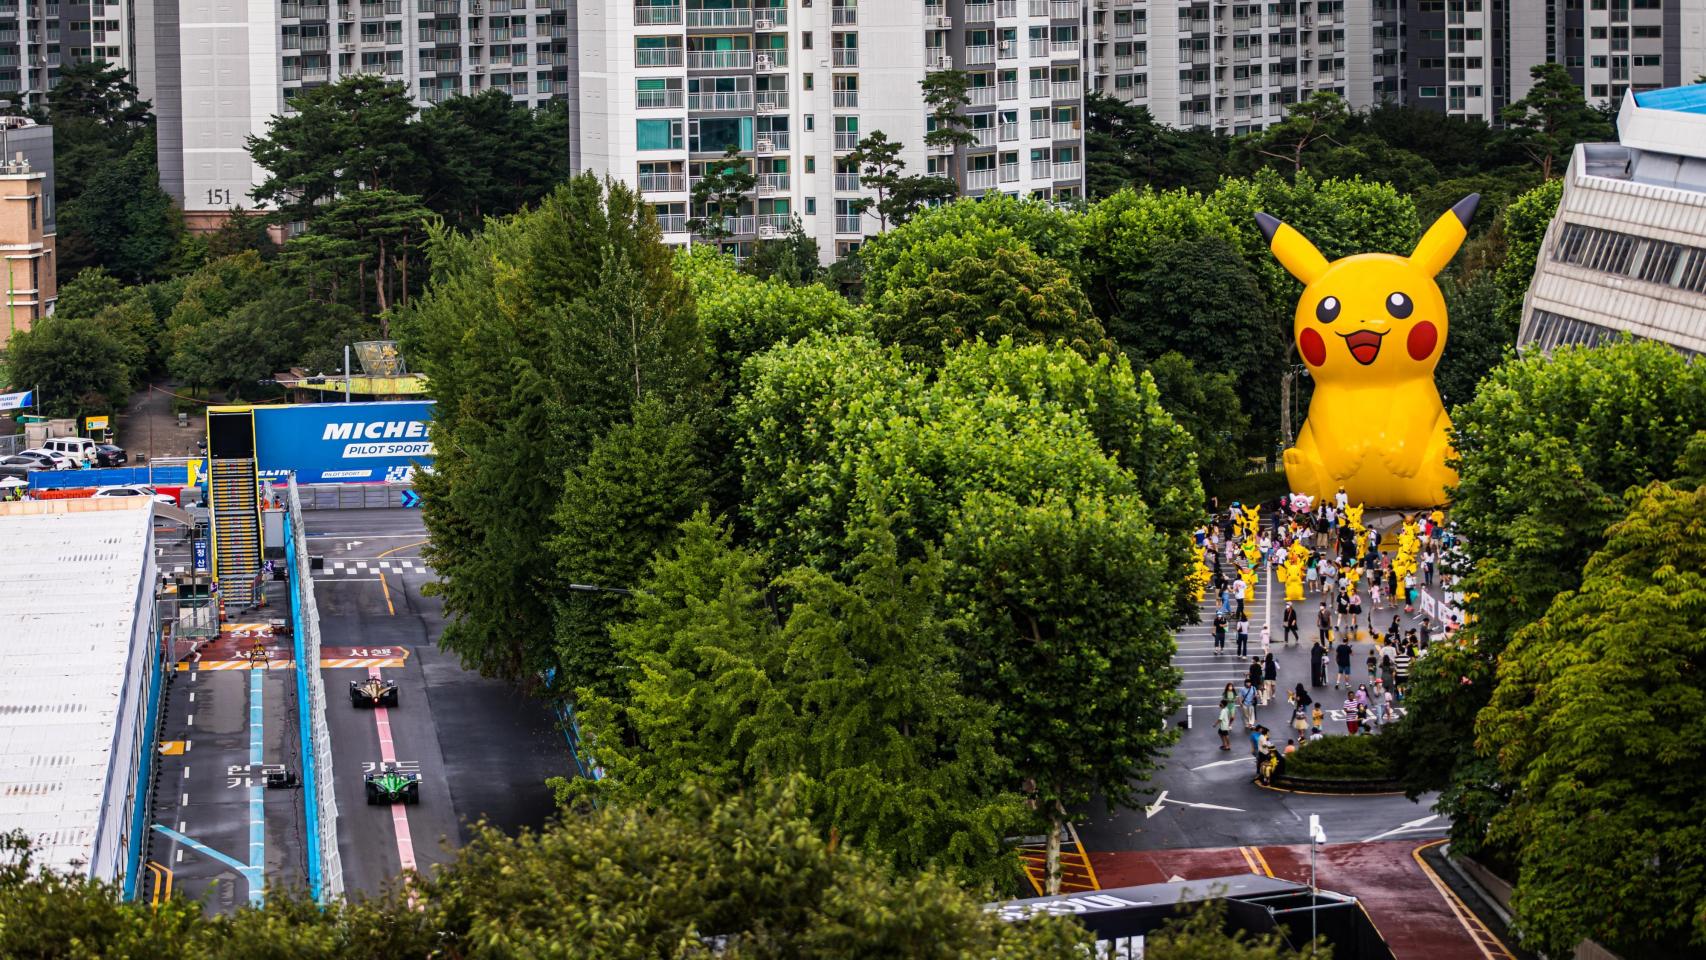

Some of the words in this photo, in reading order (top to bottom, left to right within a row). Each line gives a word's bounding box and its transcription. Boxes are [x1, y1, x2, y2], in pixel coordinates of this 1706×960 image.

[207, 189, 231, 204] 151
[349, 446, 385, 454] PILOT
[387, 444, 429, 453] SPORT
